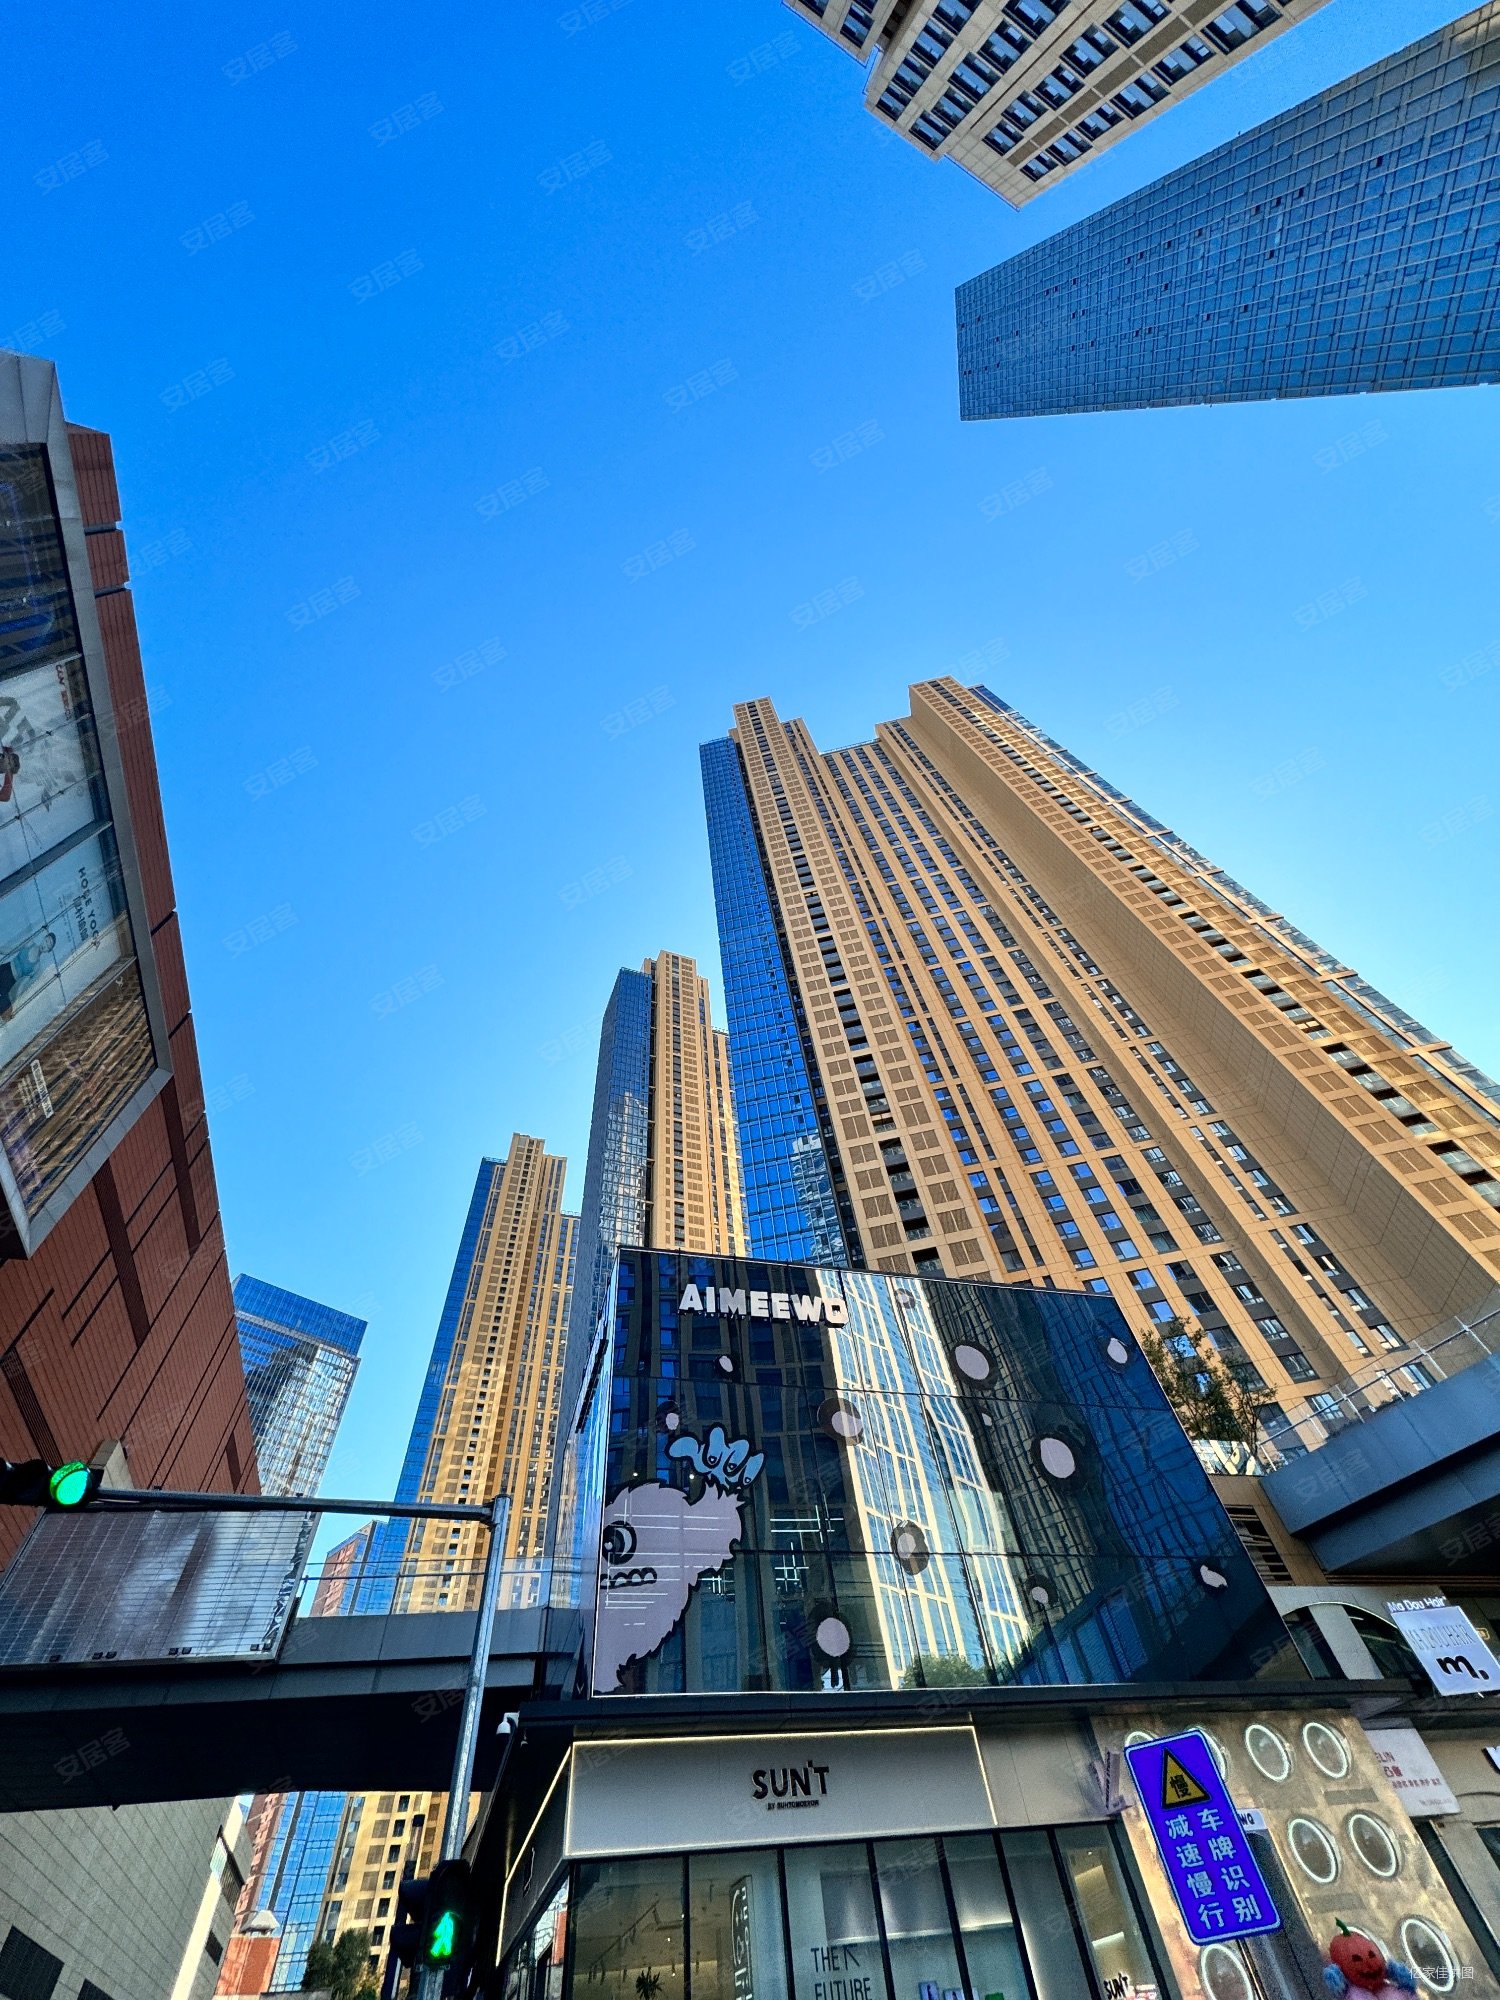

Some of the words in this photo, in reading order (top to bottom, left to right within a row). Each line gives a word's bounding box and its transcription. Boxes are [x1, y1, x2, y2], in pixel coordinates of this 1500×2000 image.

[1169, 1773, 1192, 1799] 慢
[1164, 1813, 1225, 1931] 减速慢行
[1196, 1807, 1263, 1924] 车牌识别
